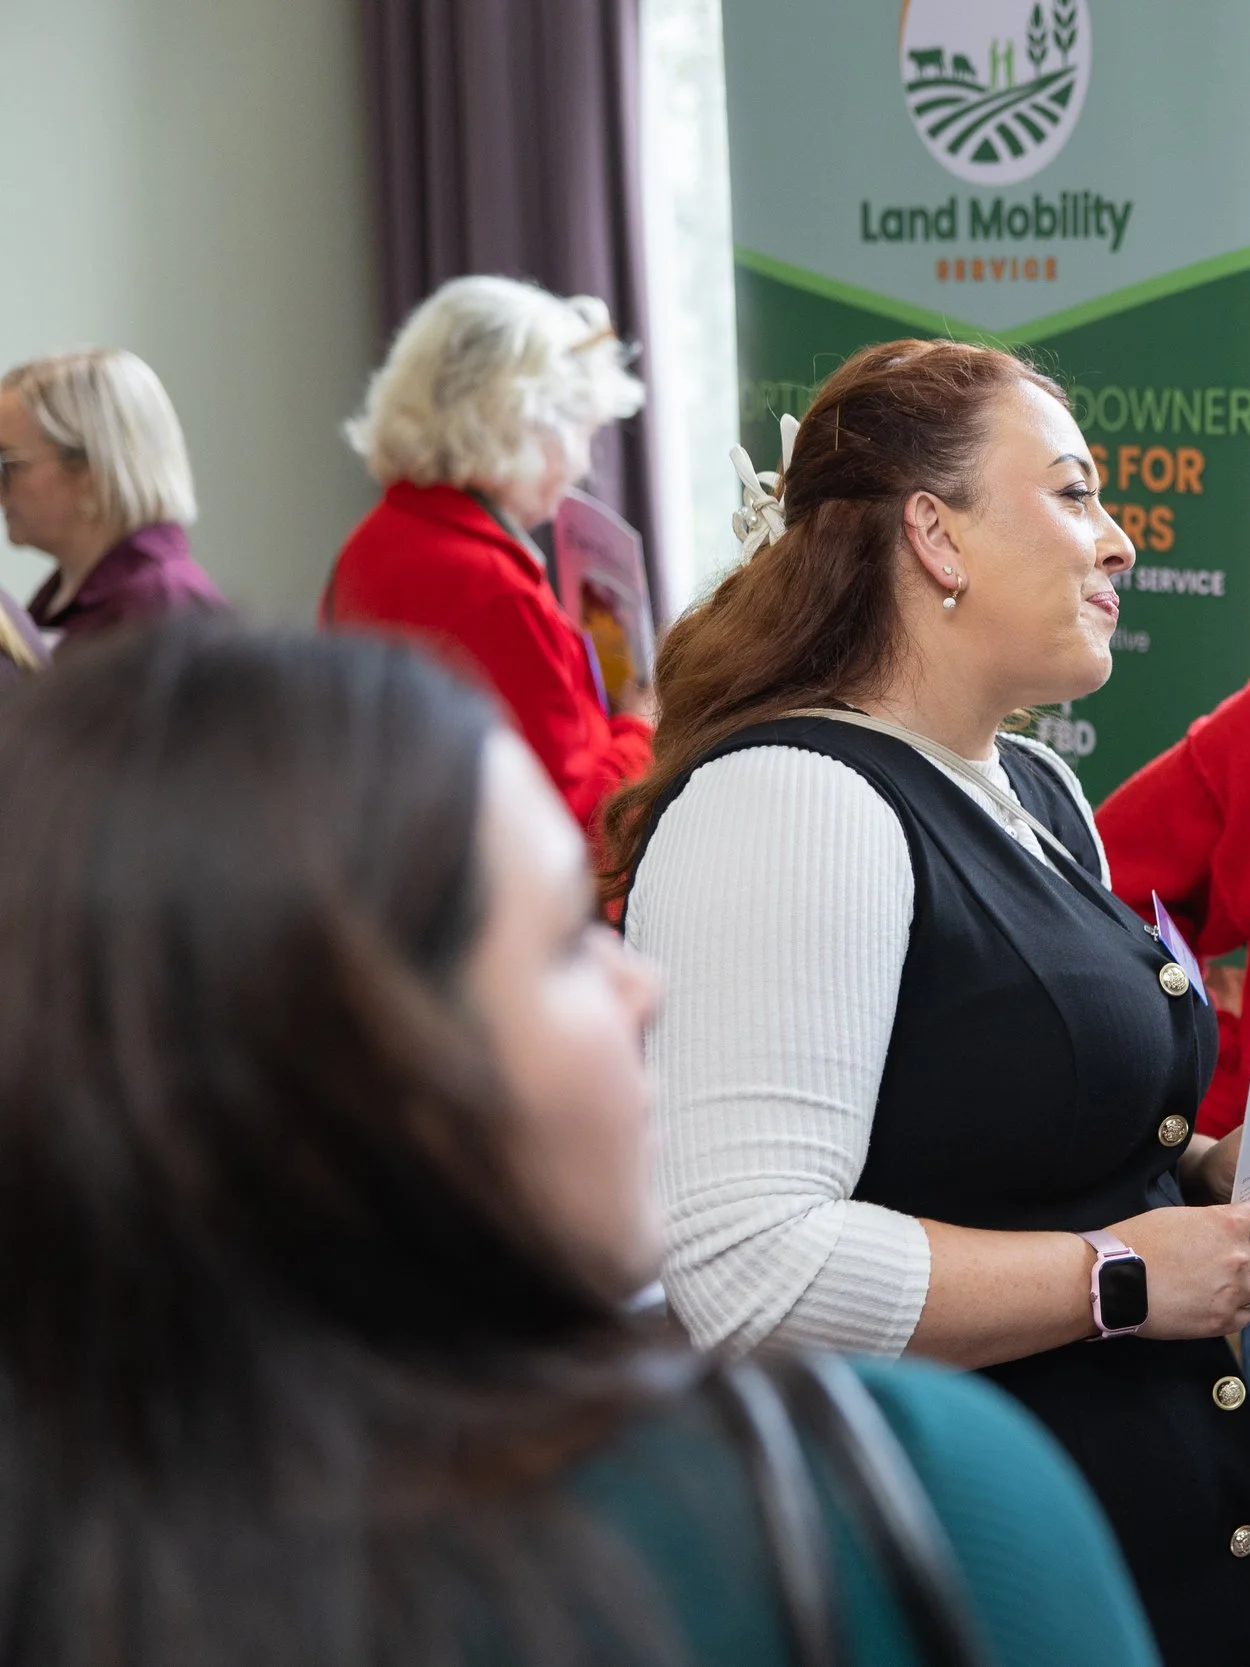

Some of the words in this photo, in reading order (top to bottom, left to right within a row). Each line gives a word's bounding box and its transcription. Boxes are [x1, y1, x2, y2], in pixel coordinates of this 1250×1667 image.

[861, 196, 958, 243] Land
[969, 190, 1134, 252] Mobility
[936, 256, 1057, 283] SERVICE
[1118, 445, 1205, 494] FOR
[1136, 566, 1225, 596] SERVICE
